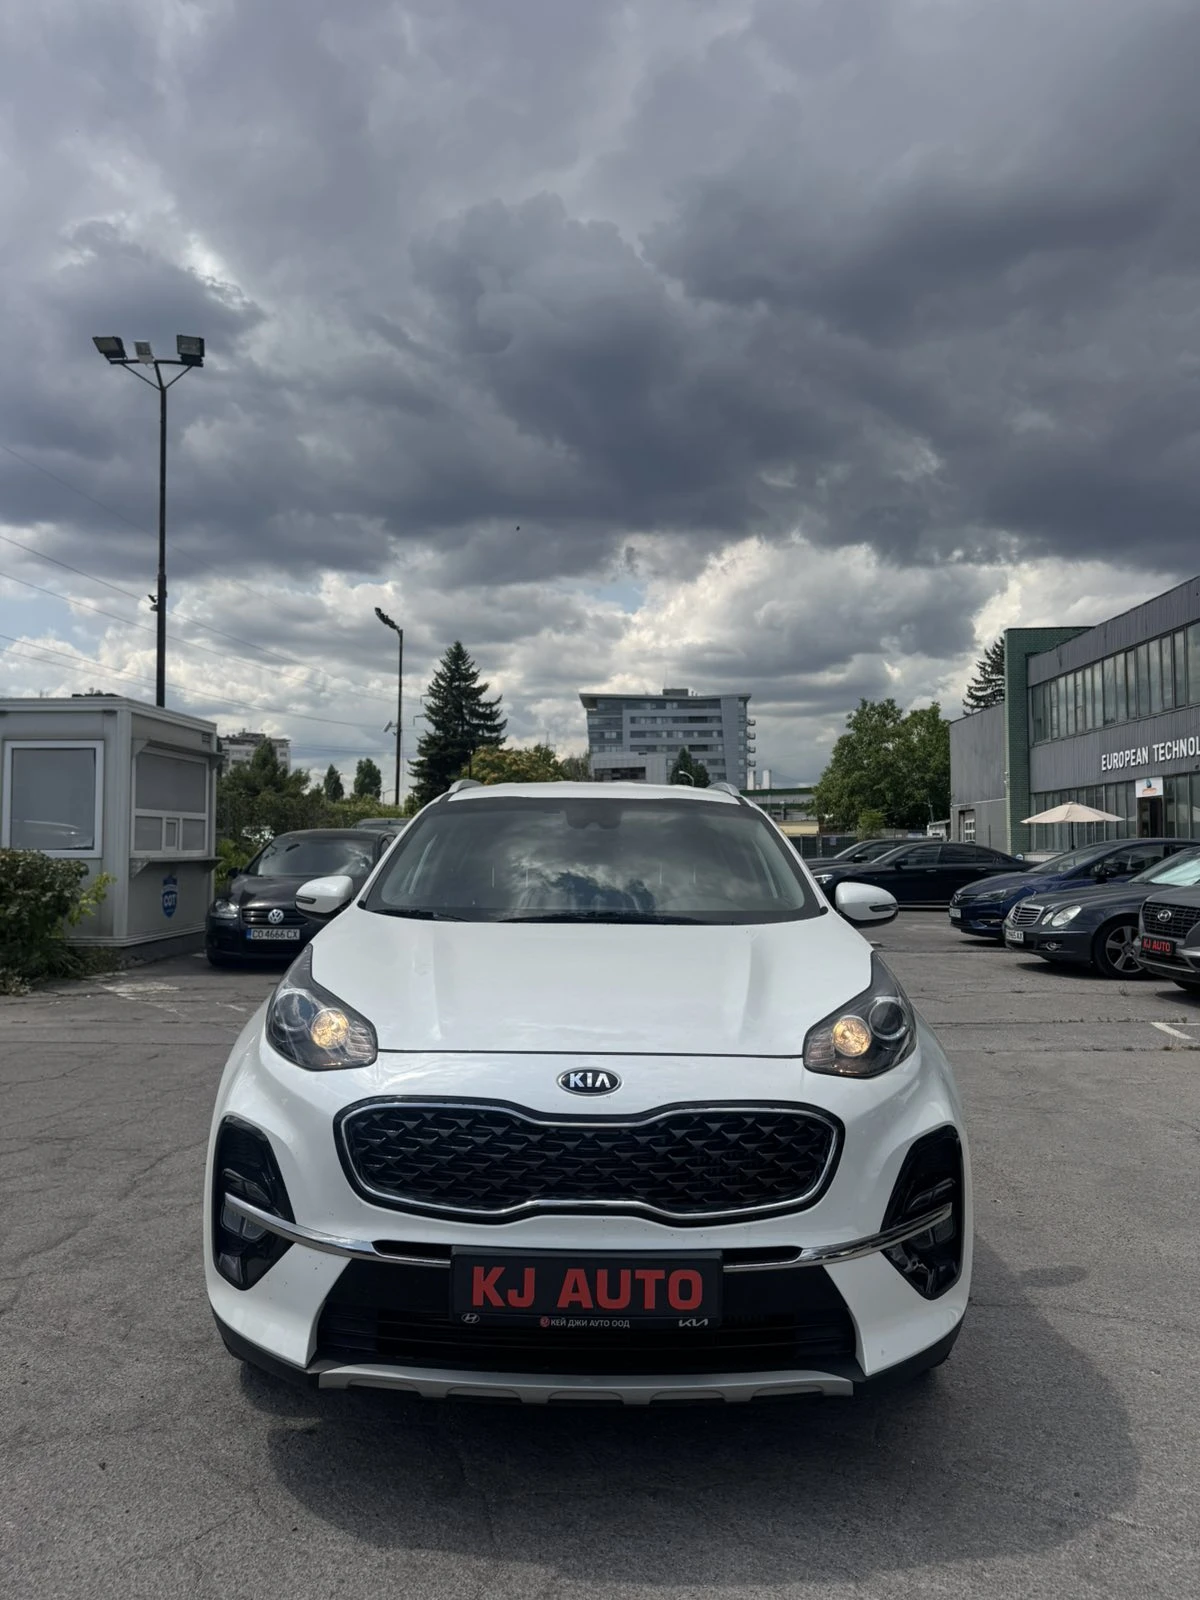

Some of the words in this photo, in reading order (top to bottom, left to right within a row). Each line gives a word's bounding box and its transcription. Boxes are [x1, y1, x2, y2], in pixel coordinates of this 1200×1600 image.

[1101, 746, 1149, 771] EUROPEAN
[265, 930, 285, 938] 4666
[1152, 939, 1171, 952] AUTO
[569, 1072, 611, 1088] KIA
[471, 1266, 536, 1308] KJ
[556, 1268, 703, 1311] AUTO
[551, 1318, 567, 1327] КЕЙ
[568, 1319, 588, 1328] ДЖИ
[589, 1319, 610, 1327] АУТО
[611, 1319, 631, 1328] ООД
